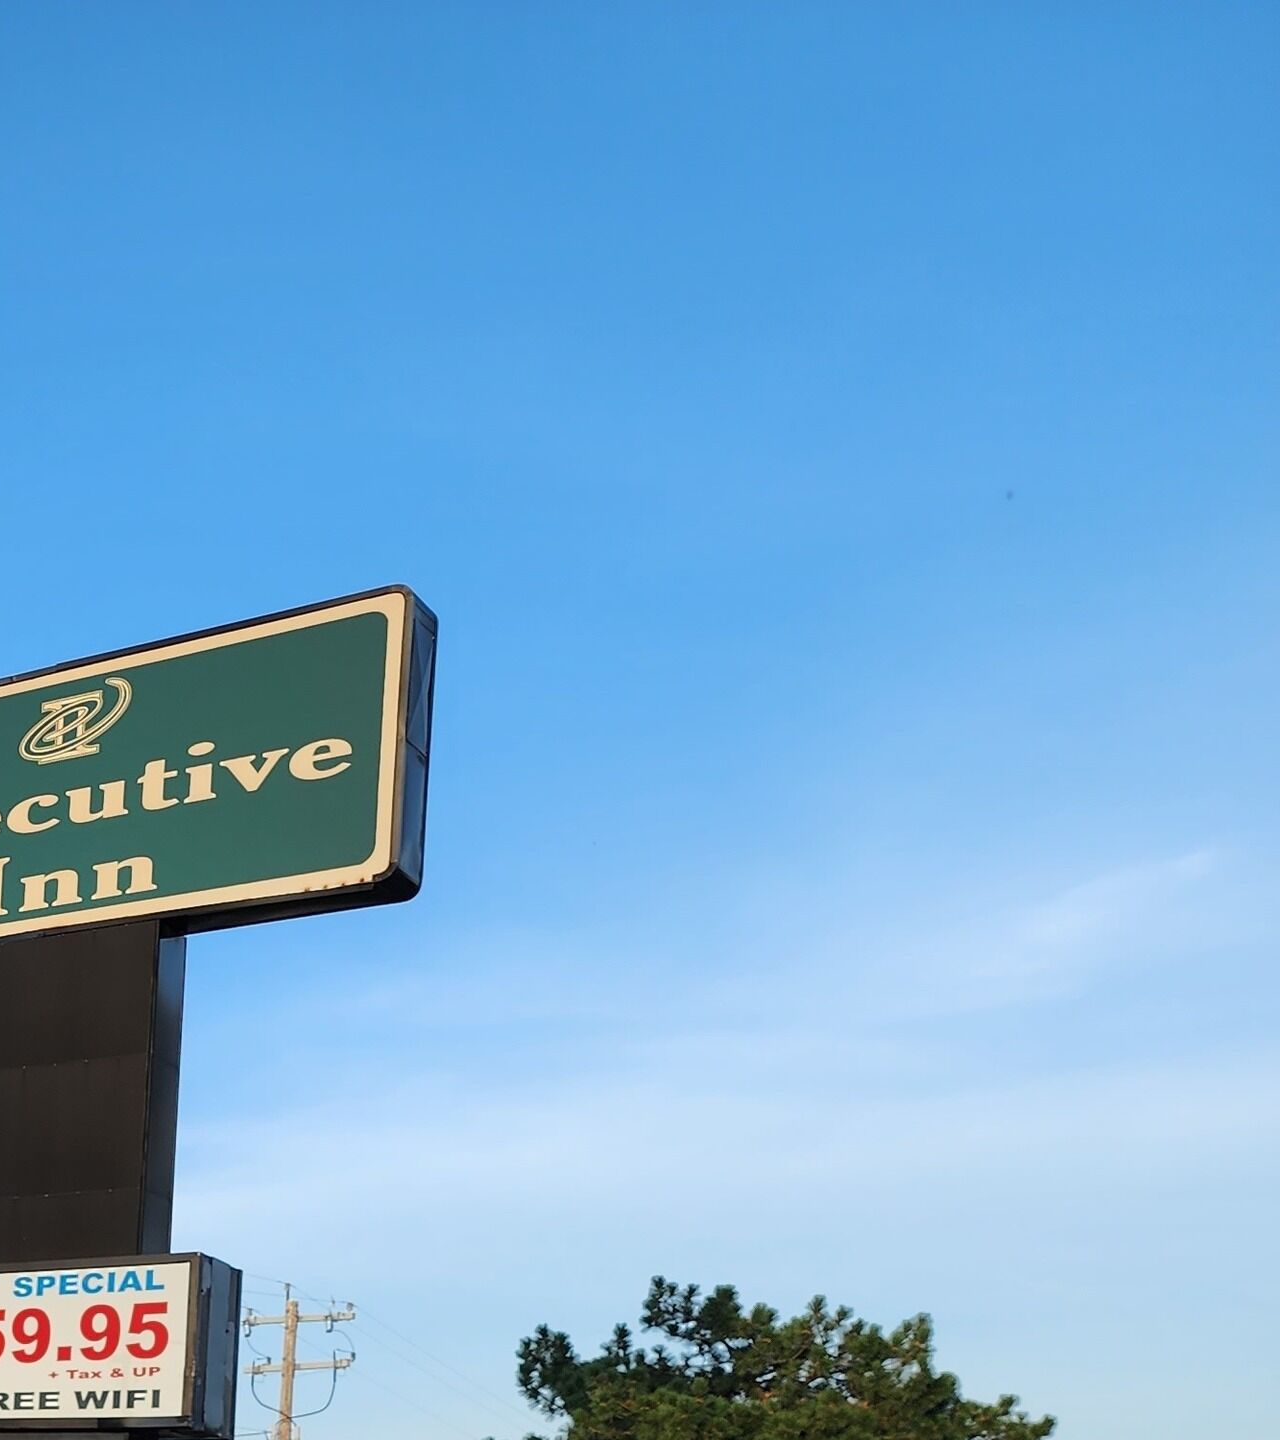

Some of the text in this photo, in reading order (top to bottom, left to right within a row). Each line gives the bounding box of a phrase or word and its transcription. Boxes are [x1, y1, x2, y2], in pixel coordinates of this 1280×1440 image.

[13, 1269, 165, 1298] SPECIAL
[66, 1368, 103, 1380] Tax
[133, 1366, 161, 1378] UP
[74, 1389, 161, 1410] WIFI
